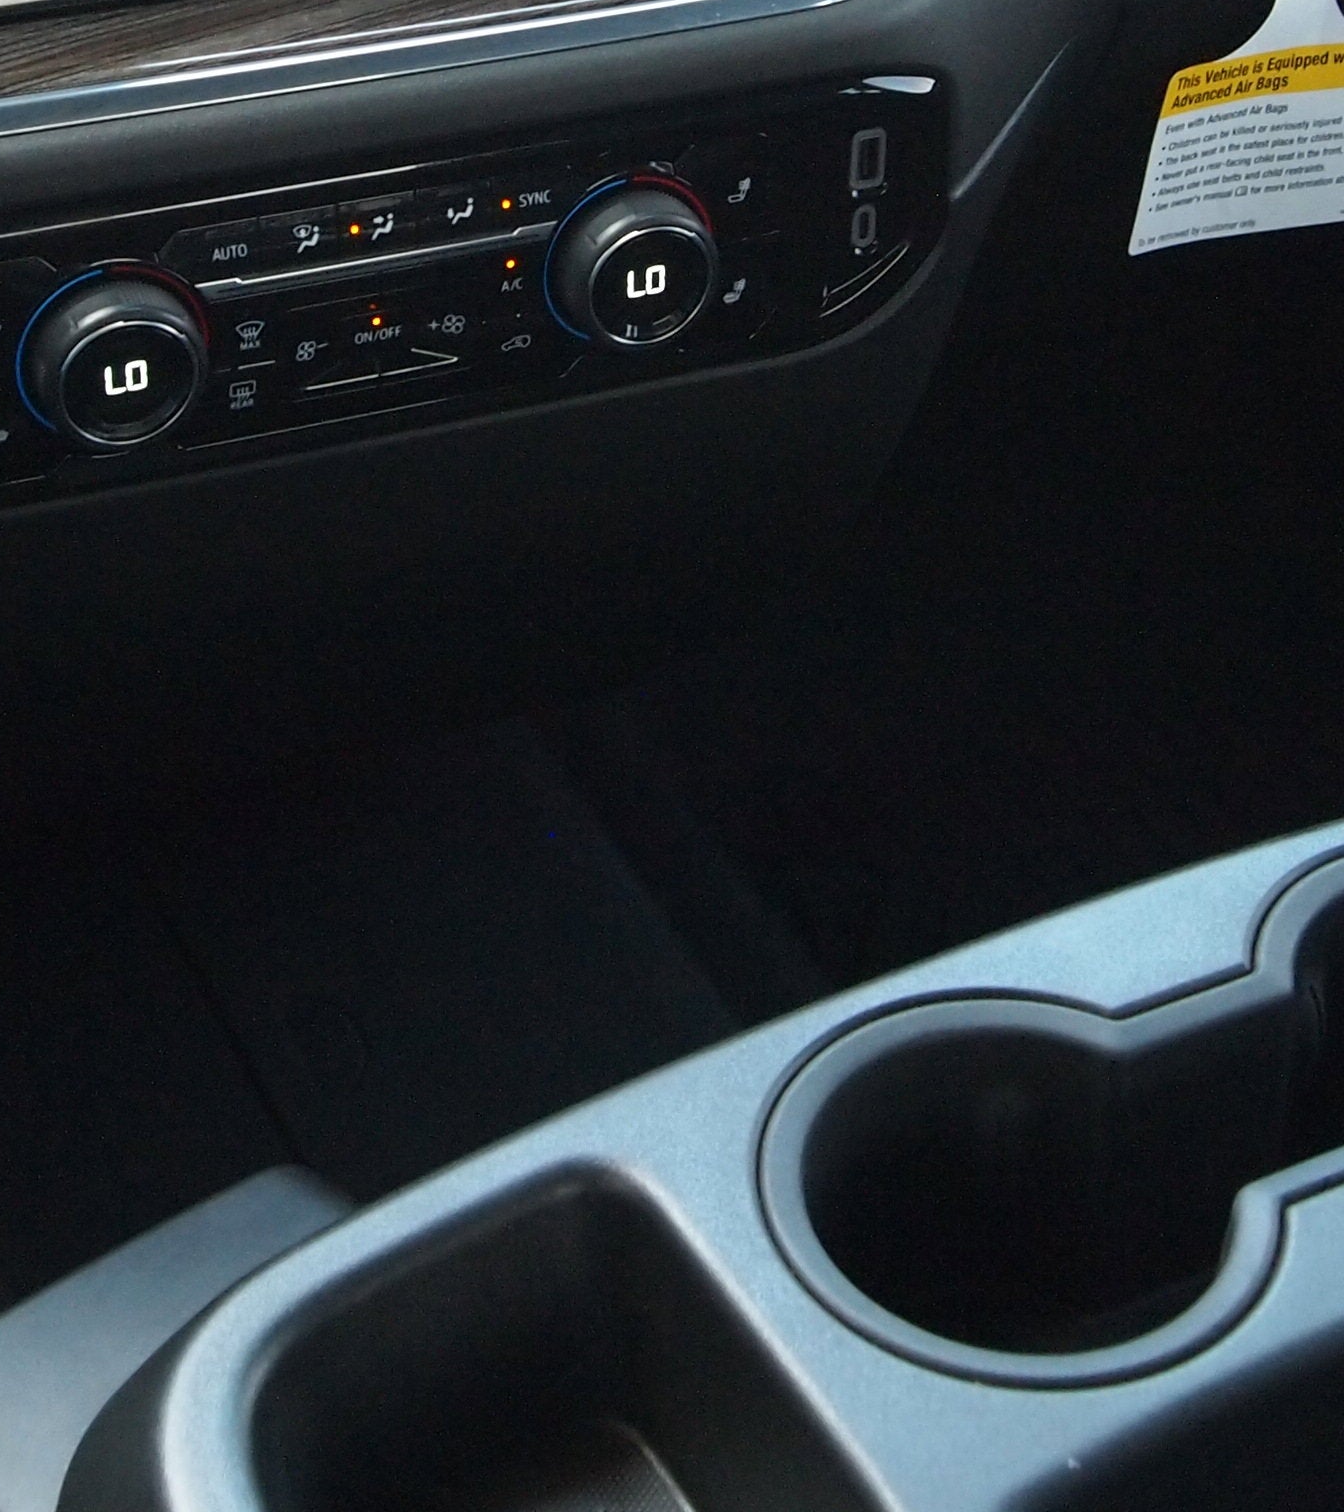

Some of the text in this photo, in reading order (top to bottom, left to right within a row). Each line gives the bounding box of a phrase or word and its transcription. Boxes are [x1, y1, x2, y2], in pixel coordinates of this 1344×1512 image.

[1178, 74, 1201, 91] This
[1205, 65, 1248, 84] Vehicle
[1252, 60, 1264, 74] is
[1267, 51, 1330, 72] Equipped
[1171, 76, 1289, 109] Advanced Air Bags
[1187, 117, 1205, 129] with
[1206, 108, 1249, 125] Advanced
[1249, 105, 1264, 115] Air
[1264, 104, 1289, 115] Bags
[1219, 130, 1230, 139] be
[1232, 126, 1256, 136] killed
[1257, 125, 1268, 133] or
[1312, 116, 1343, 128] injured
[1296, 136, 1308, 145] for
[1254, 154, 1276, 164] child
[1307, 149, 1320, 158] the
[518, 190, 552, 208] SYNC
[213, 244, 247, 260] AUTO
[501, 277, 524, 293] A/C
[627, 265, 665, 298] LO
[354, 325, 402, 345] ON/OFF
[104, 360, 148, 395] LO
